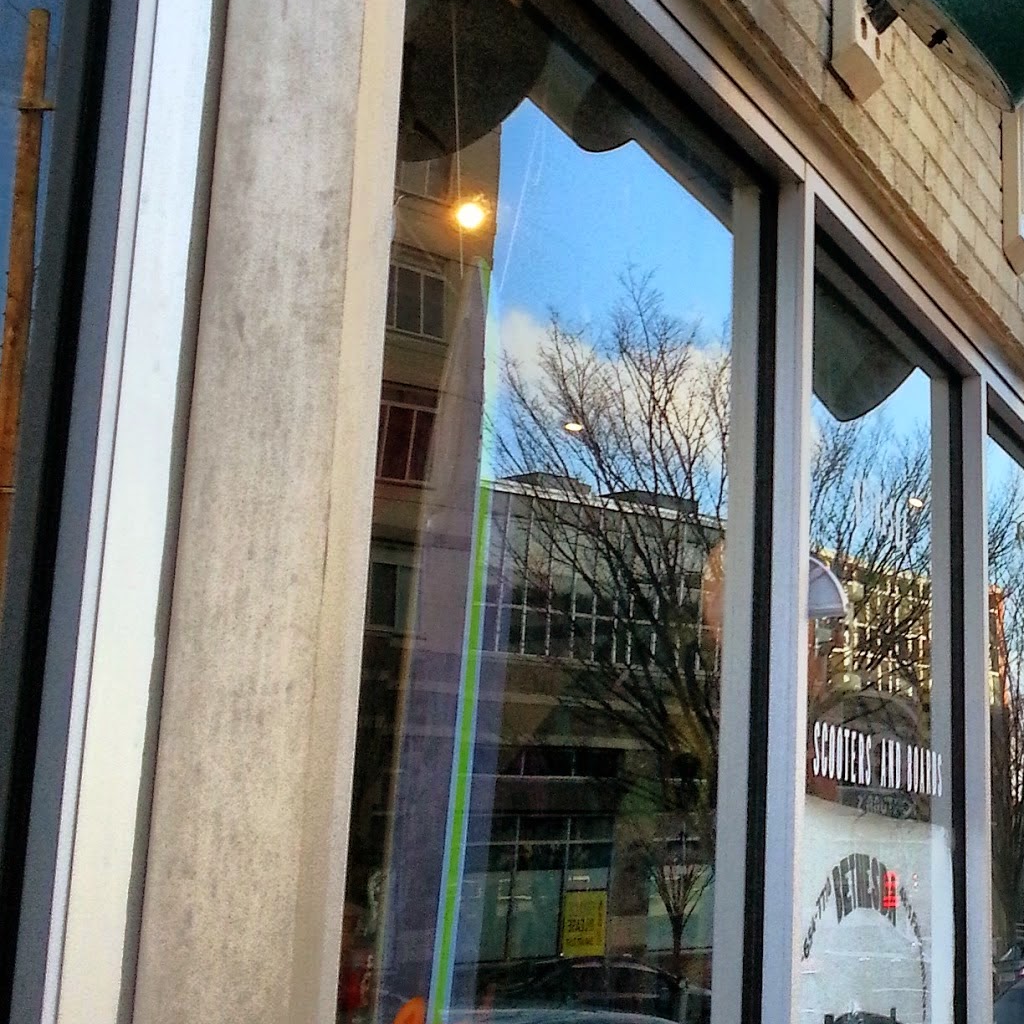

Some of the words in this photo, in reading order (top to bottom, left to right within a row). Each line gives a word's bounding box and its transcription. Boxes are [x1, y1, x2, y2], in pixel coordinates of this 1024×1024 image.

[813, 721, 872, 786] SCOOTERS
[880, 738, 901, 789] AND
[907, 744, 943, 797] BOARDS
